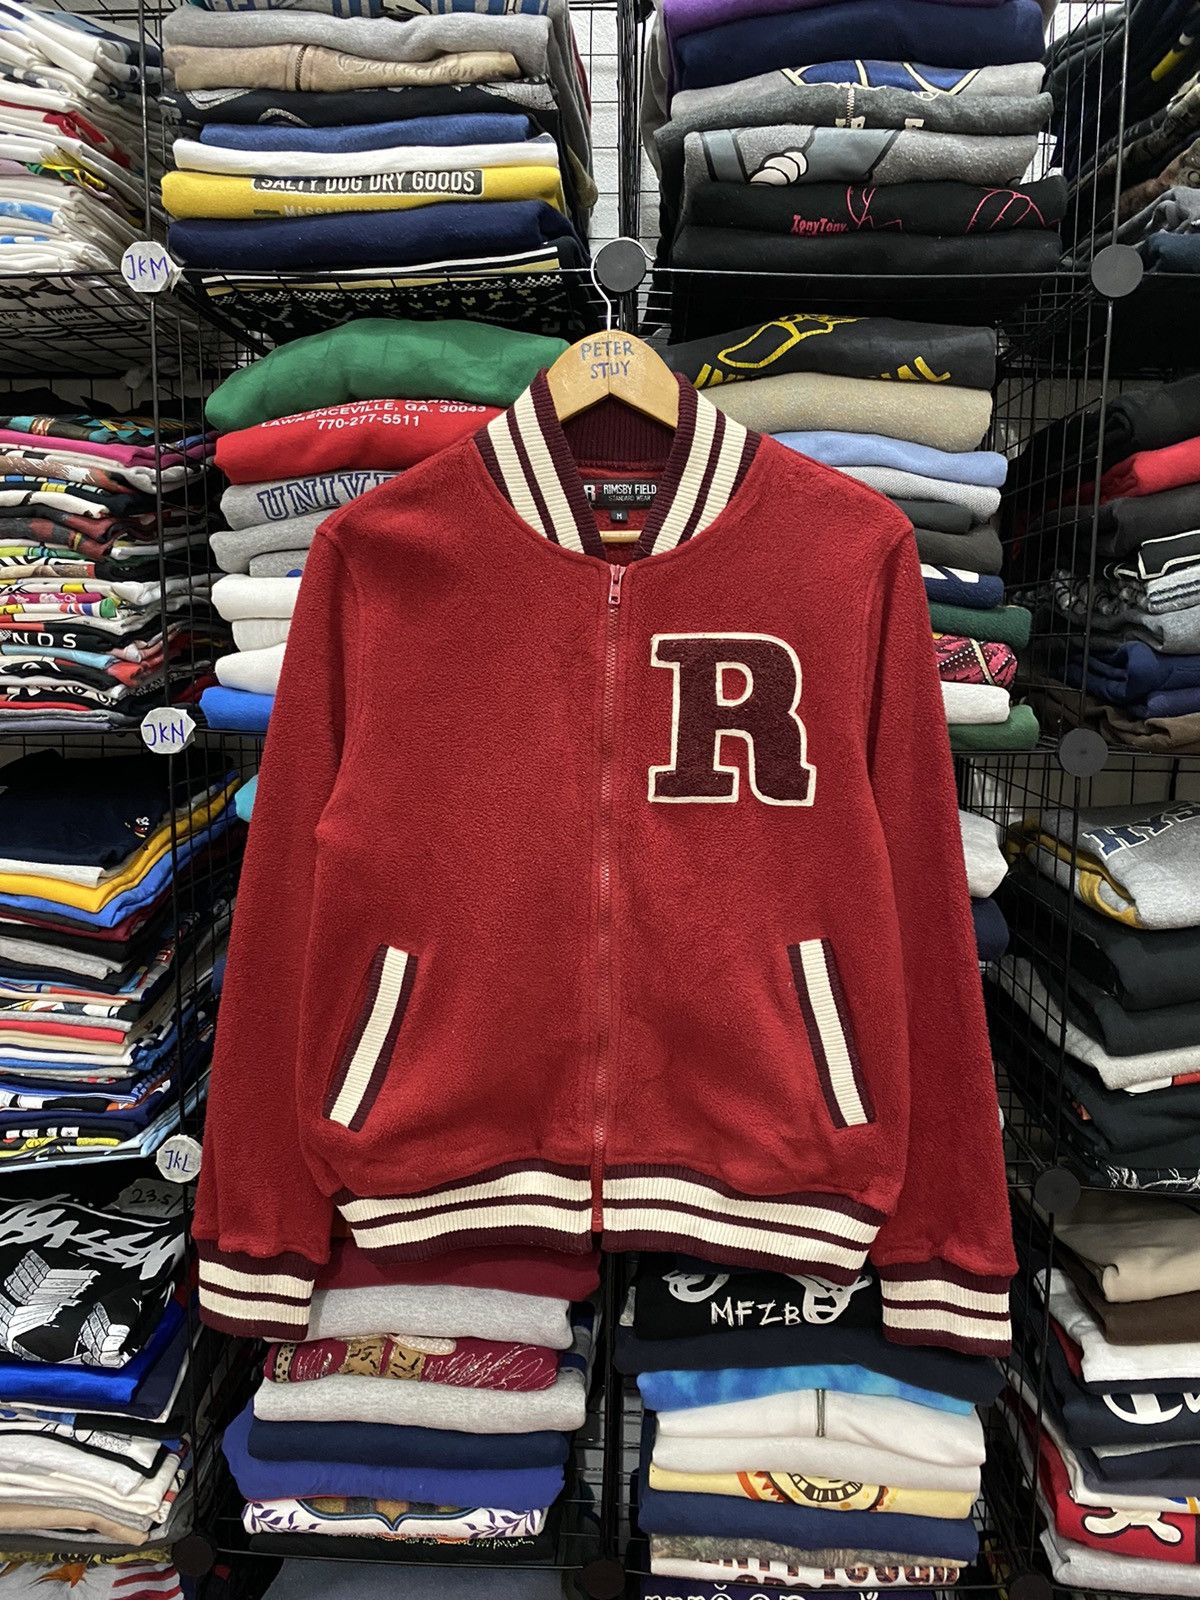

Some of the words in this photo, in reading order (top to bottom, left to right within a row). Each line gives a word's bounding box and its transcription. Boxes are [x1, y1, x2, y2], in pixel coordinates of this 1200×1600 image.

[370, 172, 405, 190] DRY
[412, 171, 475, 192] GOODS
[125, 254, 170, 280] JKM
[581, 340, 634, 361] PETER
[590, 360, 630, 379] STUY
[404, 403, 433, 413] GA.
[317, 413, 419, 430] 770-277-5511
[603, 484, 632, 495] RIMSBY
[634, 484, 657, 495] FIELD
[616, 512, 623, 520] M
[648, 631, 817, 807] R
[143, 719, 185, 747] JKN
[165, 1149, 192, 1173] JKL
